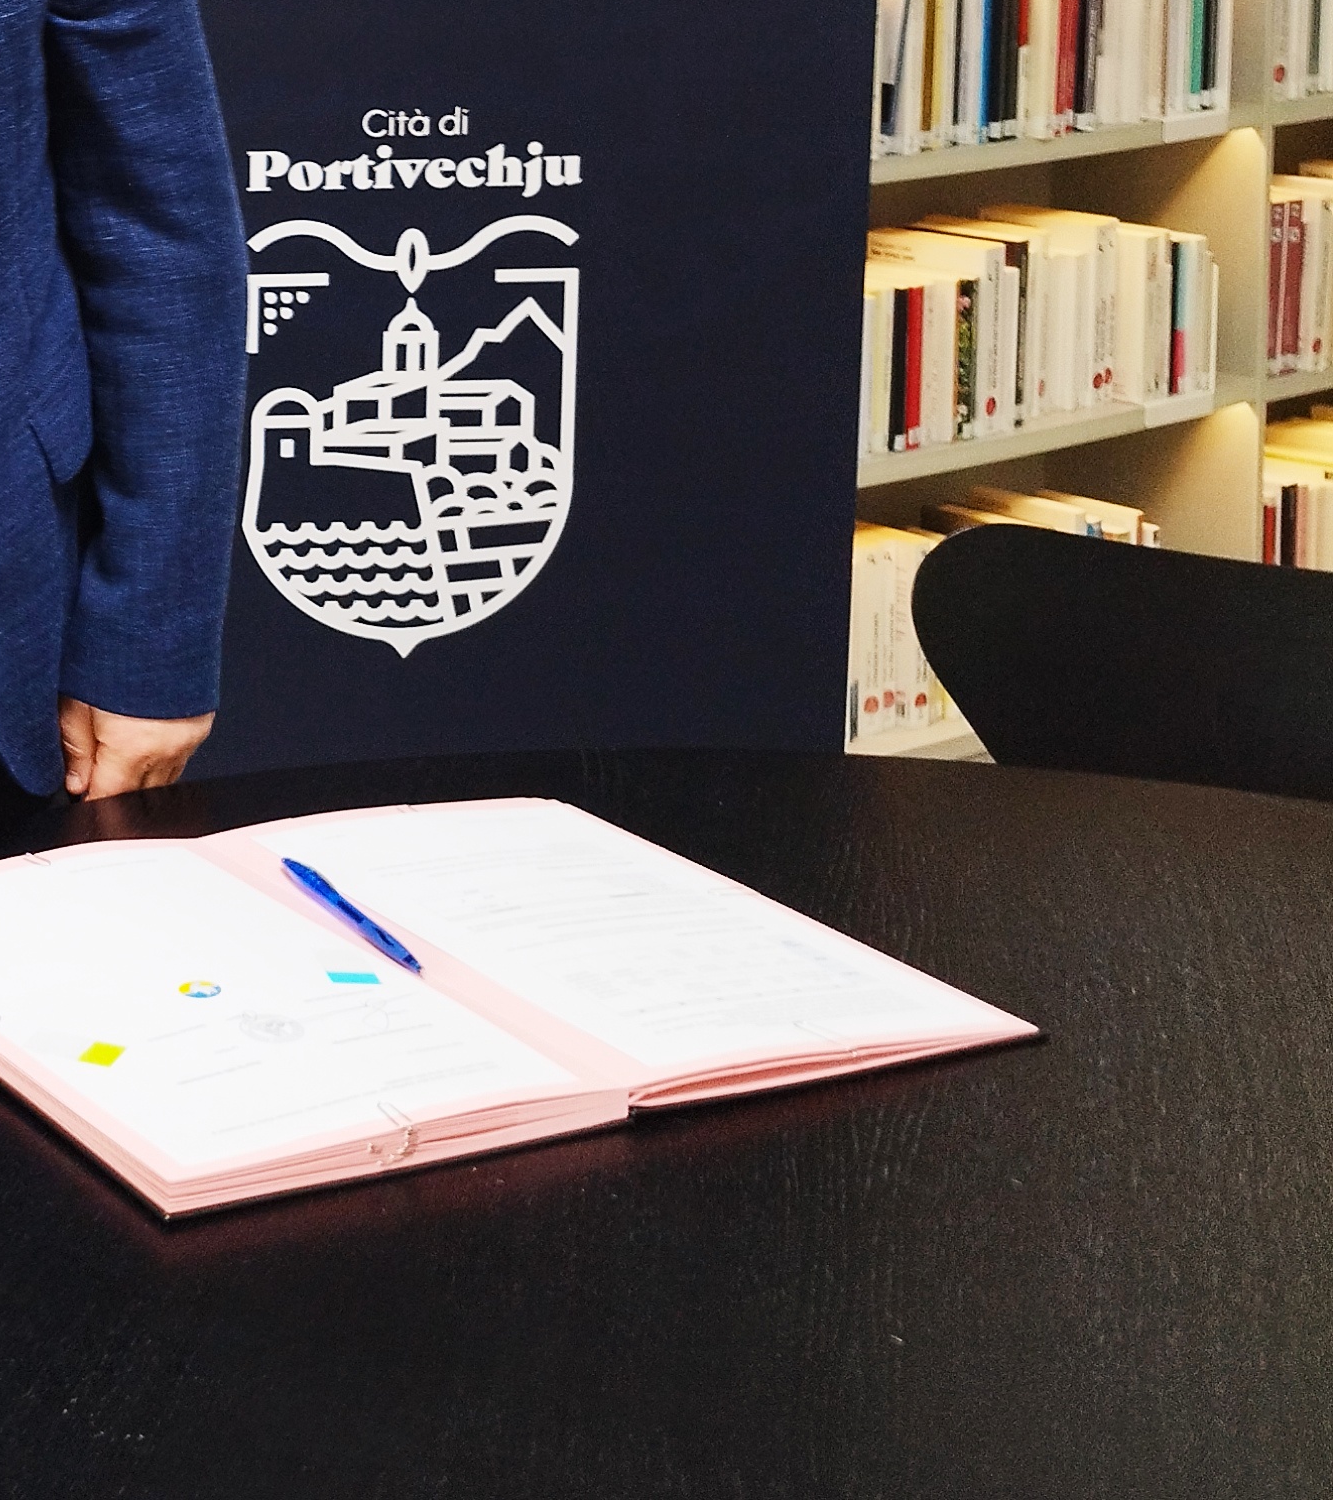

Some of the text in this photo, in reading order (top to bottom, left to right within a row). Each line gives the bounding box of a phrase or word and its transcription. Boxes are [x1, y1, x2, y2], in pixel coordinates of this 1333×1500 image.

[362, 106, 470, 138] Cità di
[246, 141, 583, 198] Portivechju
